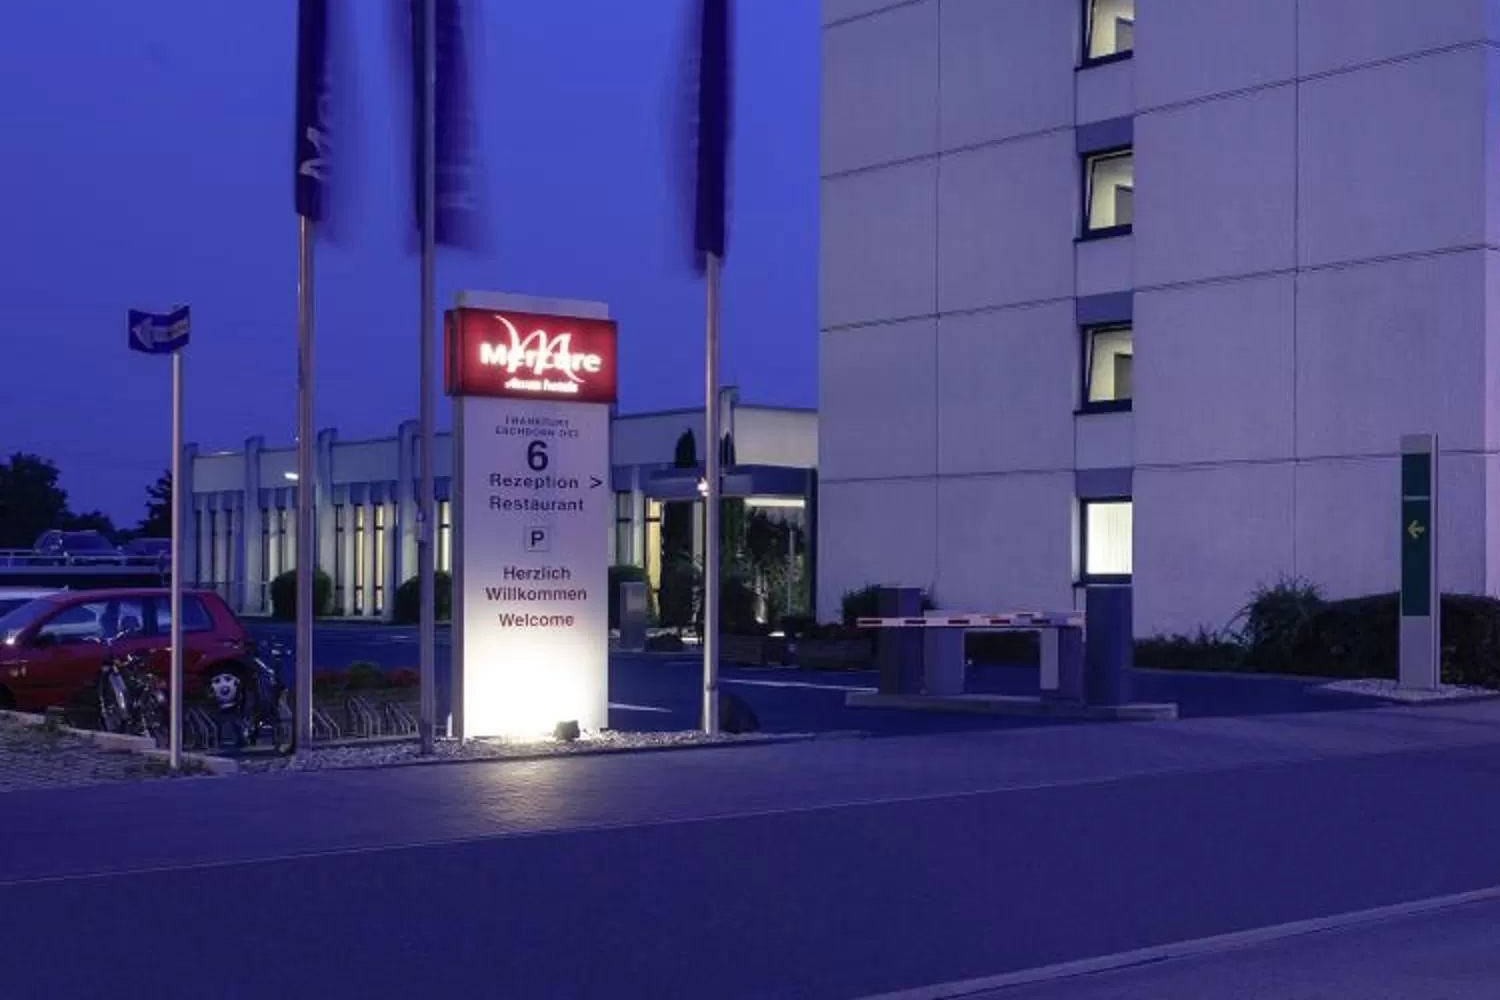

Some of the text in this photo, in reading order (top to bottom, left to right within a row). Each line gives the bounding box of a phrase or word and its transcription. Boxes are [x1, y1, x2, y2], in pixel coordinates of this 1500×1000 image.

[527, 440, 548, 471] 6
[488, 472, 579, 490] Rezeption
[488, 495, 584, 511] Restaurant
[531, 530, 545, 547] P
[503, 566, 571, 581] Herzlich
[485, 587, 588, 601] Willkommen
[498, 613, 574, 627] Welcome
